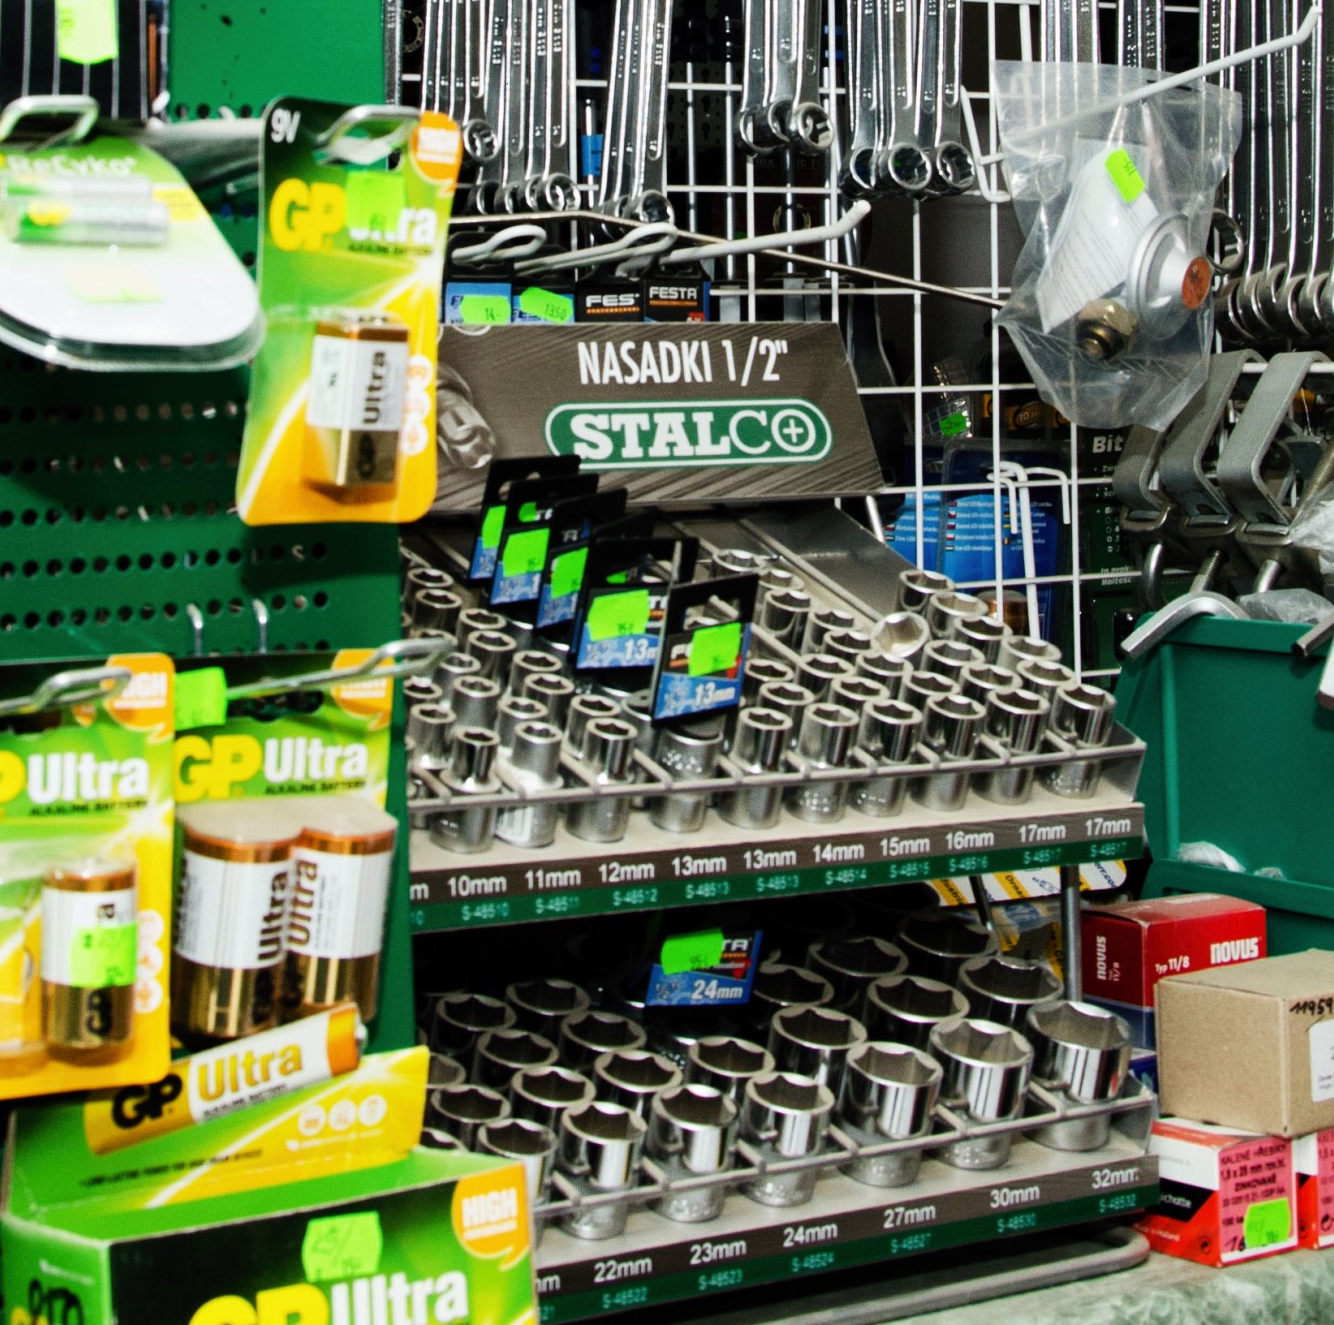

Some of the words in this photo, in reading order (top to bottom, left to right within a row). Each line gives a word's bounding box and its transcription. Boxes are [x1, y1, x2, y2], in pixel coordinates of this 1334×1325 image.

[270, 109, 301, 144] 9V
[269, 177, 345, 253] GP
[649, 286, 697, 300] FESTA
[362, 350, 387, 426] Ultra
[577, 340, 712, 386] NASADKI
[721, 336, 789, 387] 1/2"
[570, 408, 817, 461] STALCO
[694, 681, 736, 707] 13mm
[27, 751, 149, 804] Ultra
[174, 734, 262, 803] GP
[264, 735, 368, 781] Ultra
[447, 875, 507, 898] 10mm
[524, 867, 582, 890] 11mm
[598, 861, 655, 884] 12mm
[671, 854, 728, 877] 13mm
[743, 848, 797, 870] 13mm
[812, 841, 865, 863] 14mm
[879, 836, 931, 857] 15mm
[945, 830, 995, 851] 16mm
[1018, 823, 1067, 844] 17mm
[1085, 817, 1132, 837] 17mm
[258, 870, 289, 963] Ultra
[285, 859, 319, 948] Ultra
[691, 979, 744, 1001] 24mm
[1154, 962, 1168, 974] Typ
[1168, 955, 1190, 971] 11/8
[111, 1071, 182, 1132] GP
[197, 1041, 303, 1103] Ultra
[462, 1186, 517, 1225] HIGH
[594, 1256, 653, 1284] 22mm
[689, 1239, 747, 1266] 23mm
[782, 1222, 838, 1248] 24mm
[883, 1203, 936, 1229] 27mm
[990, 1184, 1040, 1208] 30mm
[330, 1268, 470, 1325] Ultra
